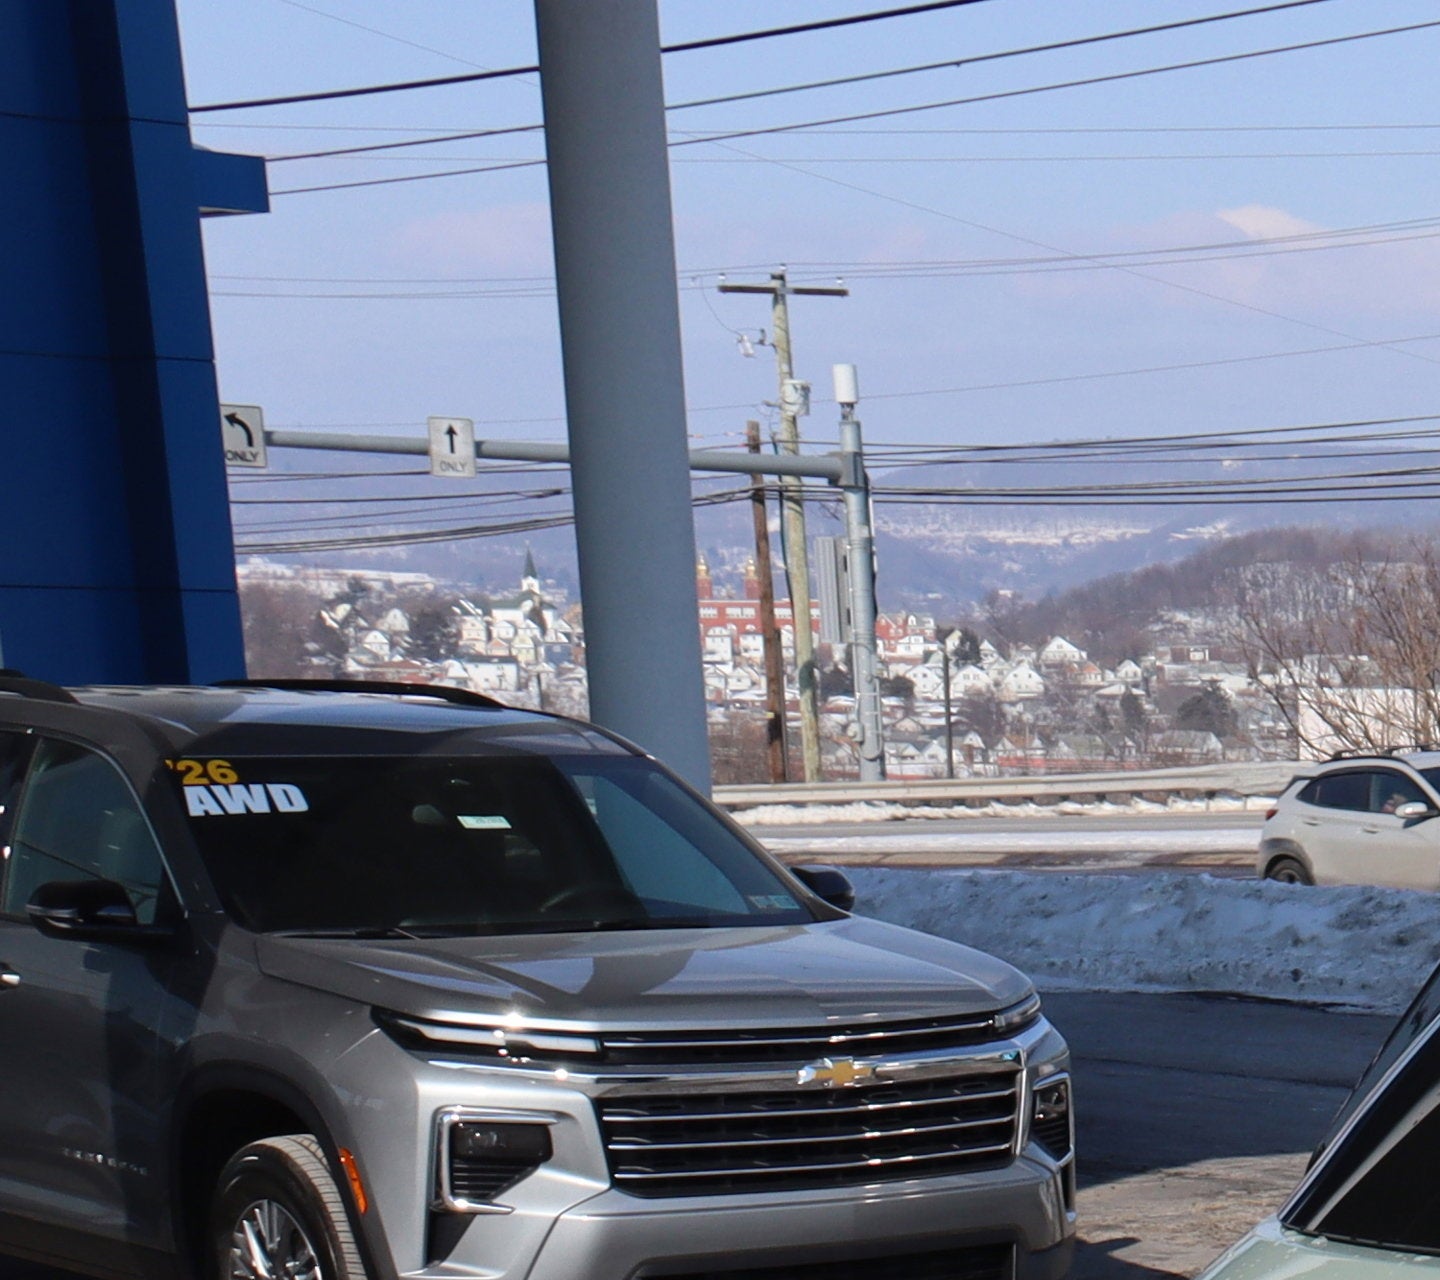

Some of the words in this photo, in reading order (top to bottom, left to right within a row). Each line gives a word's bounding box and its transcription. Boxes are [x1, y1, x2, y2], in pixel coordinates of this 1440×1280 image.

[226, 449, 258, 462] ONLY
[440, 460, 467, 473] ONLY
[183, 783, 310, 817] AWD
